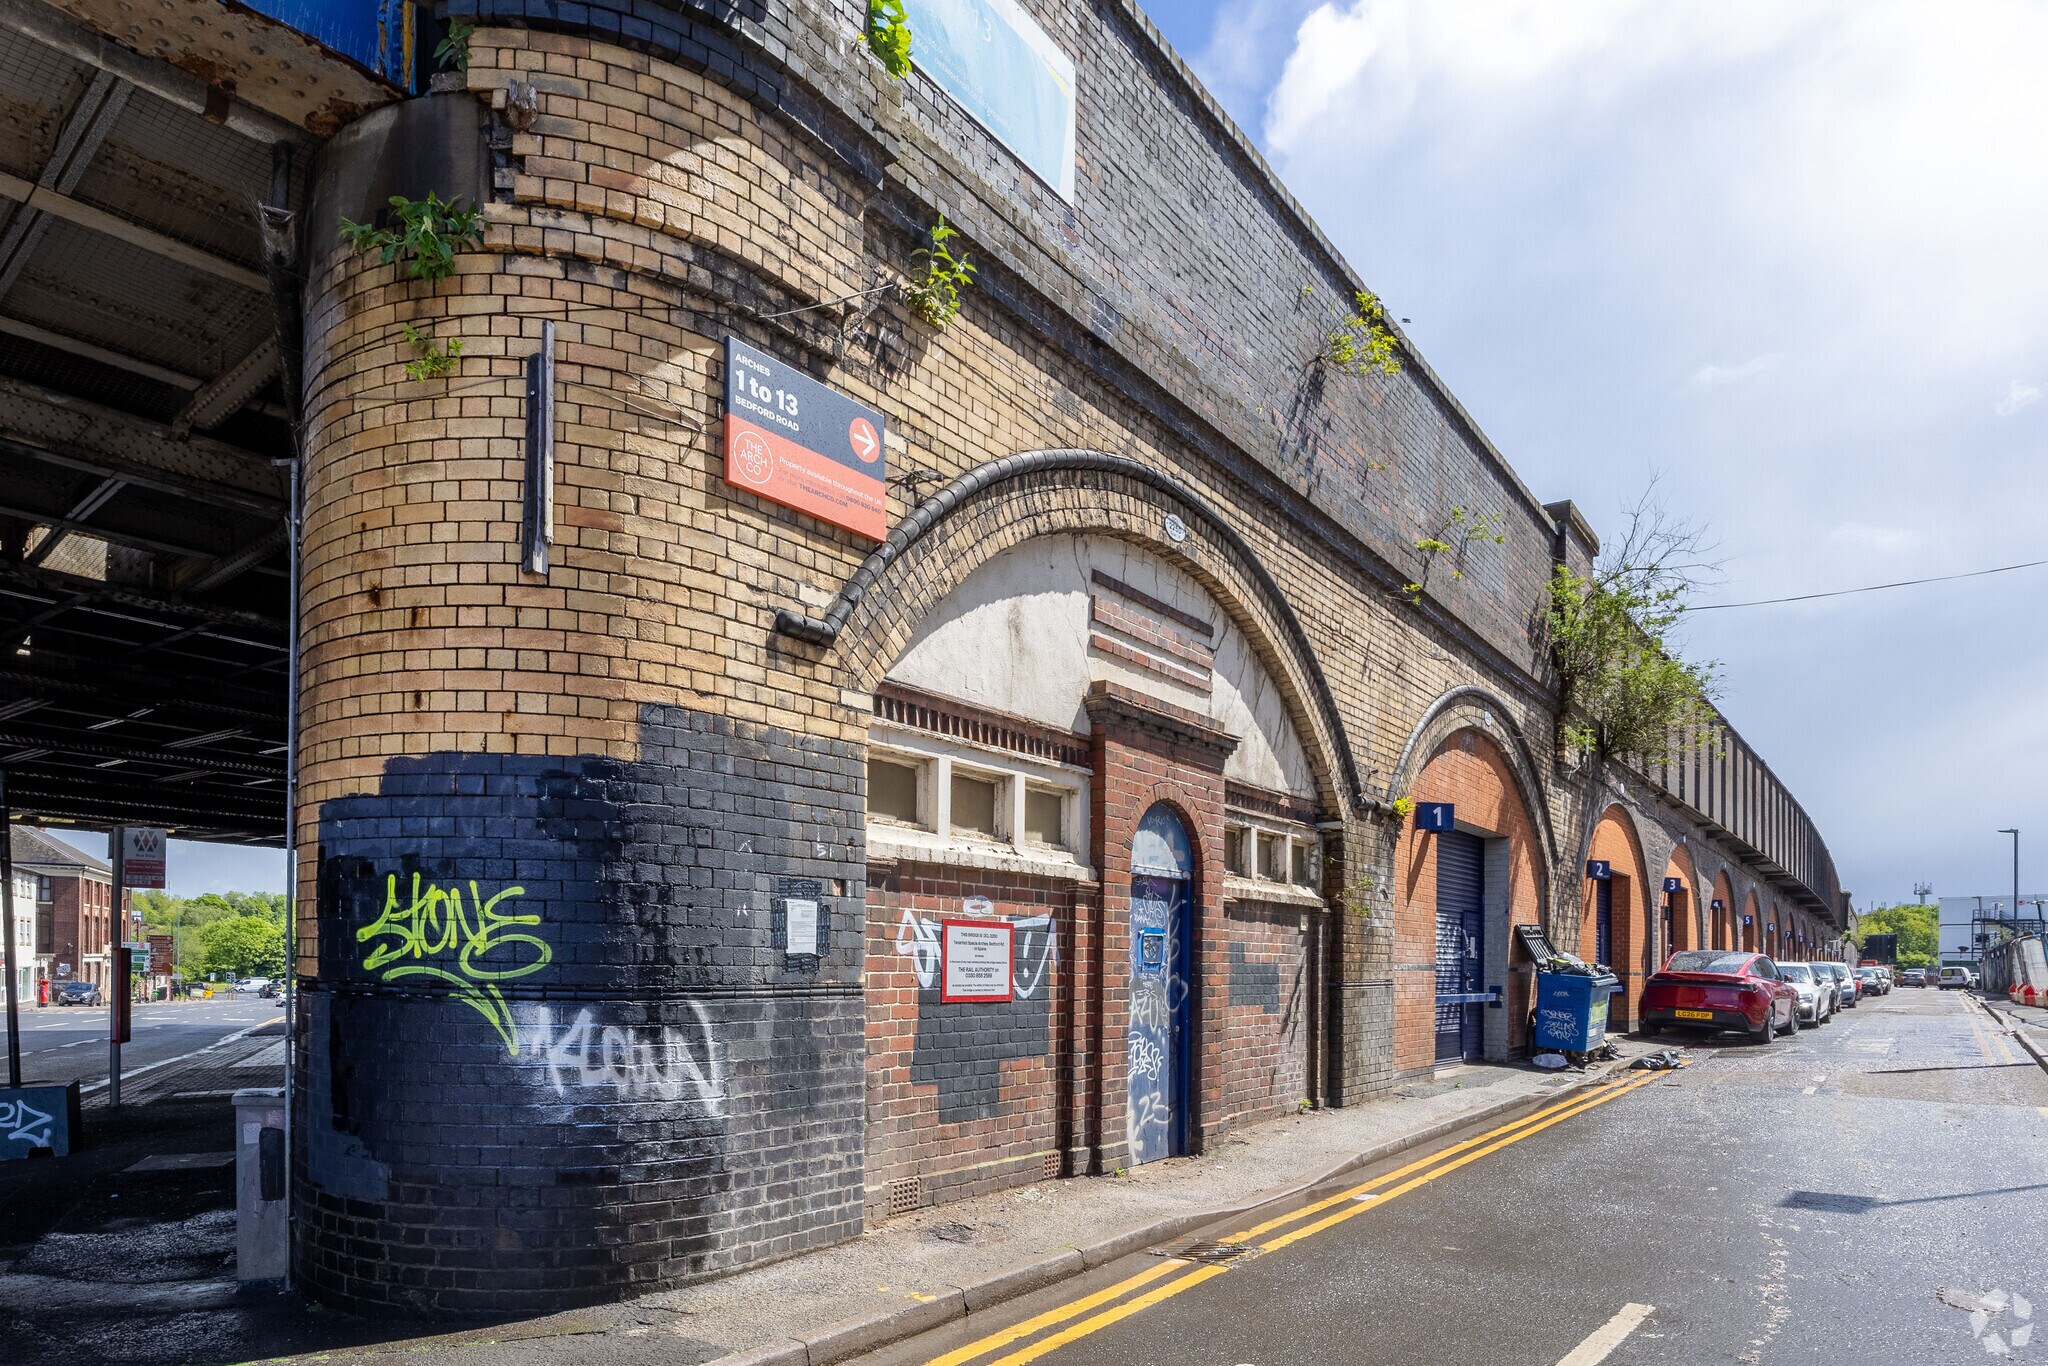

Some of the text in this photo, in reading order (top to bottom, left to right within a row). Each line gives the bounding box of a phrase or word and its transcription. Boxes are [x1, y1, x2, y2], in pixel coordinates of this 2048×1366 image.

[735, 353, 770, 377] ARCHES
[736, 370, 798, 416] 1 to 13
[735, 395, 799, 432] BEDFORD ROAD
[744, 440, 763, 453] THE
[740, 450, 768, 468] ARCH
[746, 461, 762, 476] CO
[780, 456, 805, 474] Property
[806, 470, 832, 484] available
[832, 480, 864, 498] throughout
[864, 493, 873, 502] the
[874, 498, 883, 506] UK
[800, 483, 848, 508] THEARCHCO.COM
[1433, 806, 1442, 826] 1
[1596, 862, 1604, 876] 2
[1669, 879, 1676, 890] 3
